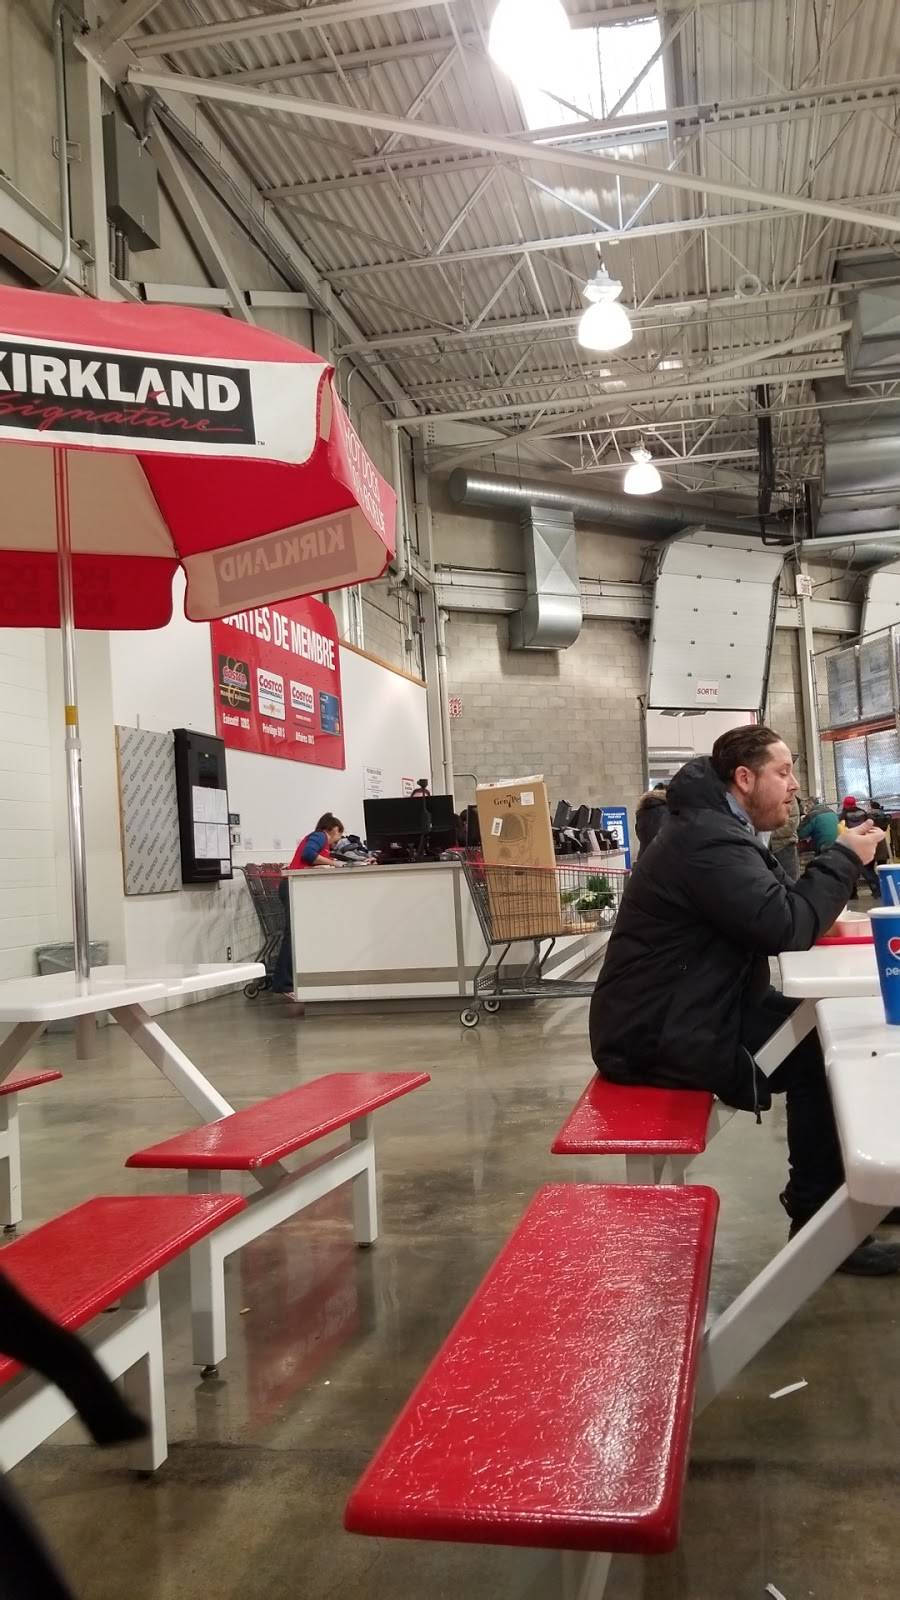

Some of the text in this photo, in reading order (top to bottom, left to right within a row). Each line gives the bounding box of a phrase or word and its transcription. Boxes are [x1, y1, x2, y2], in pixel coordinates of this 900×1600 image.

[272, 611, 290, 651] DE
[290, 620, 336, 671] MEMBRE
[259, 674, 283, 693] COSTCO
[696, 687, 719, 696] SORTIE
[292, 687, 313, 703] COSTCO
